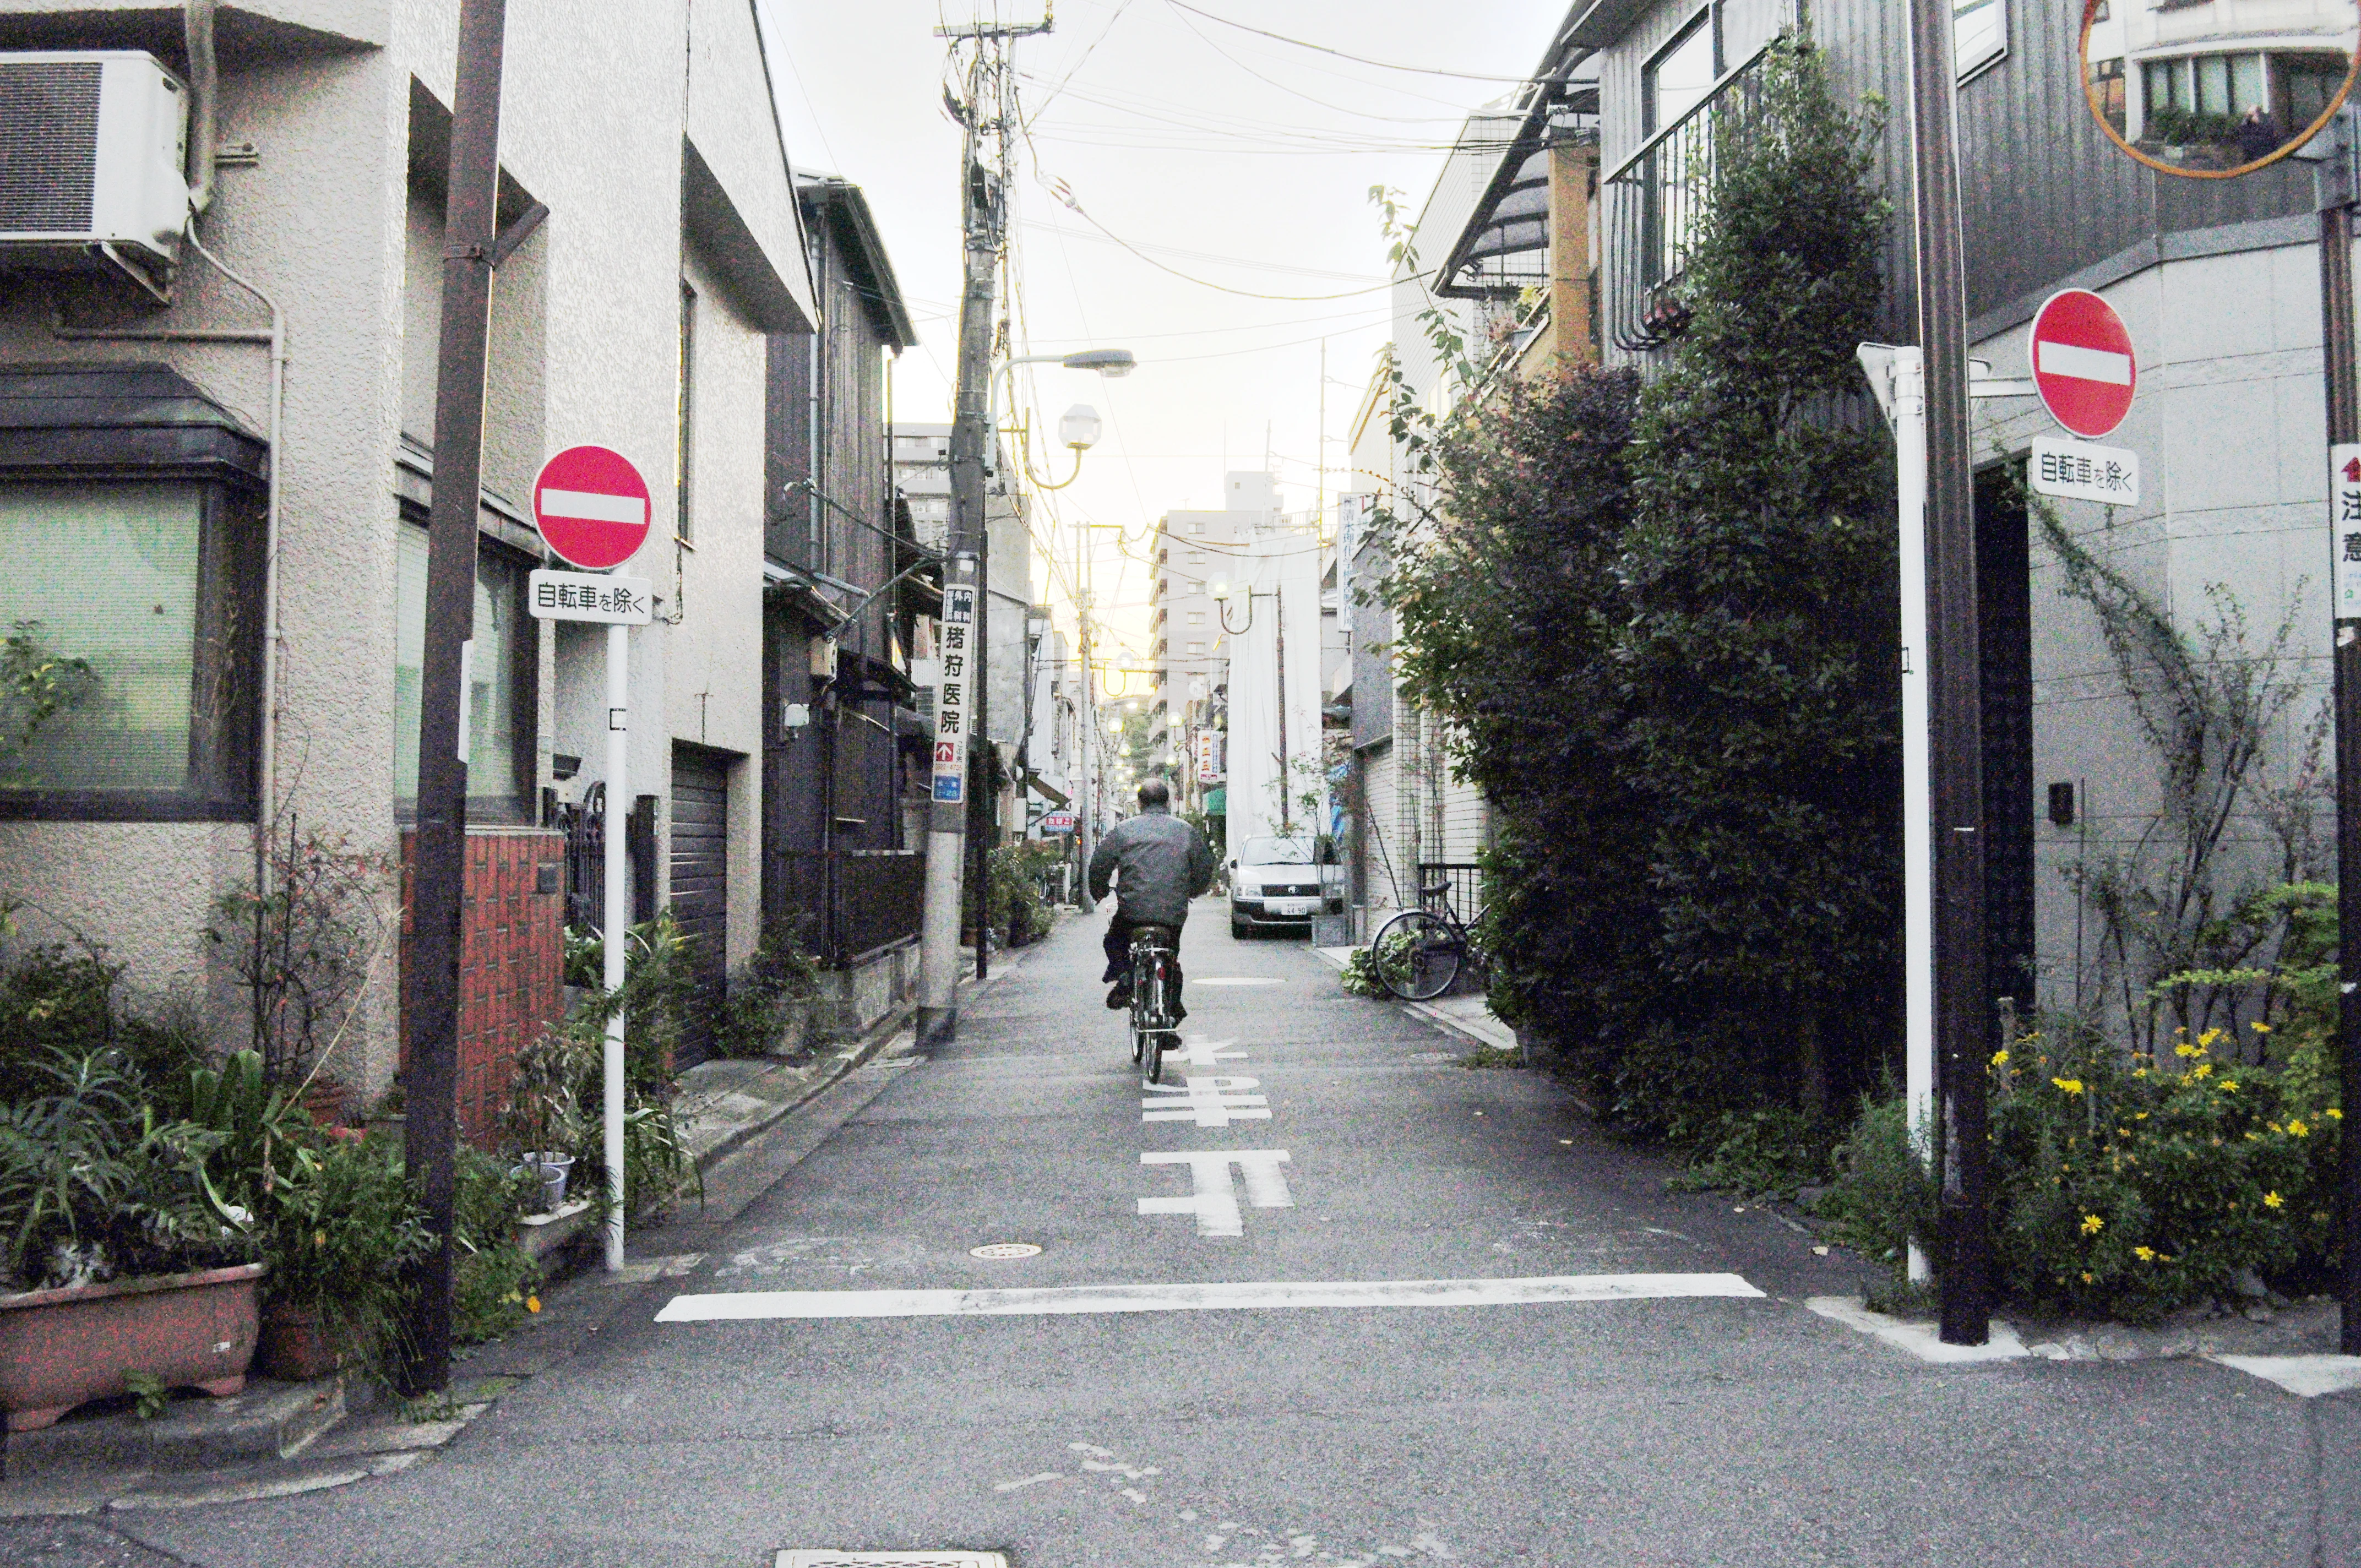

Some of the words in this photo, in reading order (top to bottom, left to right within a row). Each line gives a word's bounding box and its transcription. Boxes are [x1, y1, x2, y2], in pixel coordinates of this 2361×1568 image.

[2041, 451, 2132, 493] 自転車を除く
[538, 581, 645, 614] 自転車を除く
[940, 626, 965, 734] 猪狩医院
